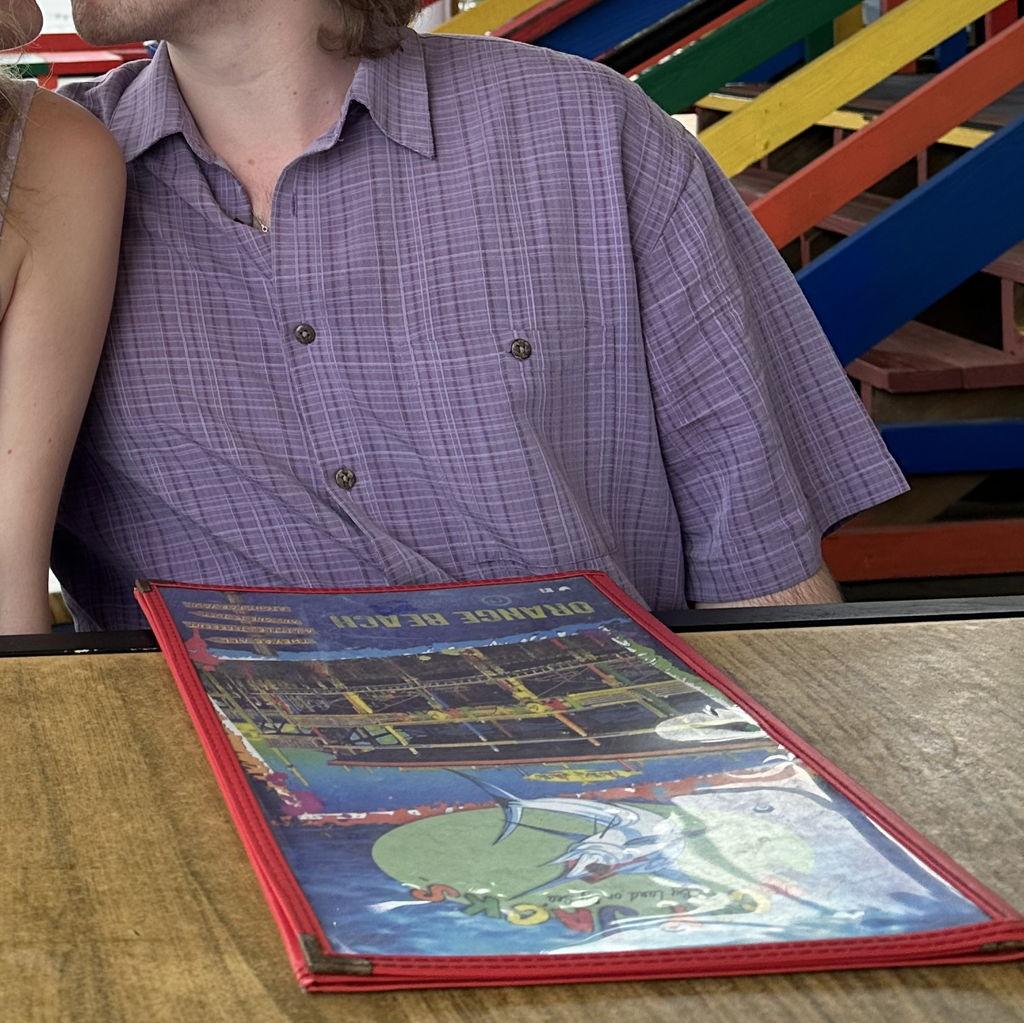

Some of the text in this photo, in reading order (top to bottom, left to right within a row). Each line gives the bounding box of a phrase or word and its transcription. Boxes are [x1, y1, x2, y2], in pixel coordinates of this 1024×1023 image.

[329, 600, 595, 629] ORANGE BEACH
[408, 883, 643, 933] JACKS
